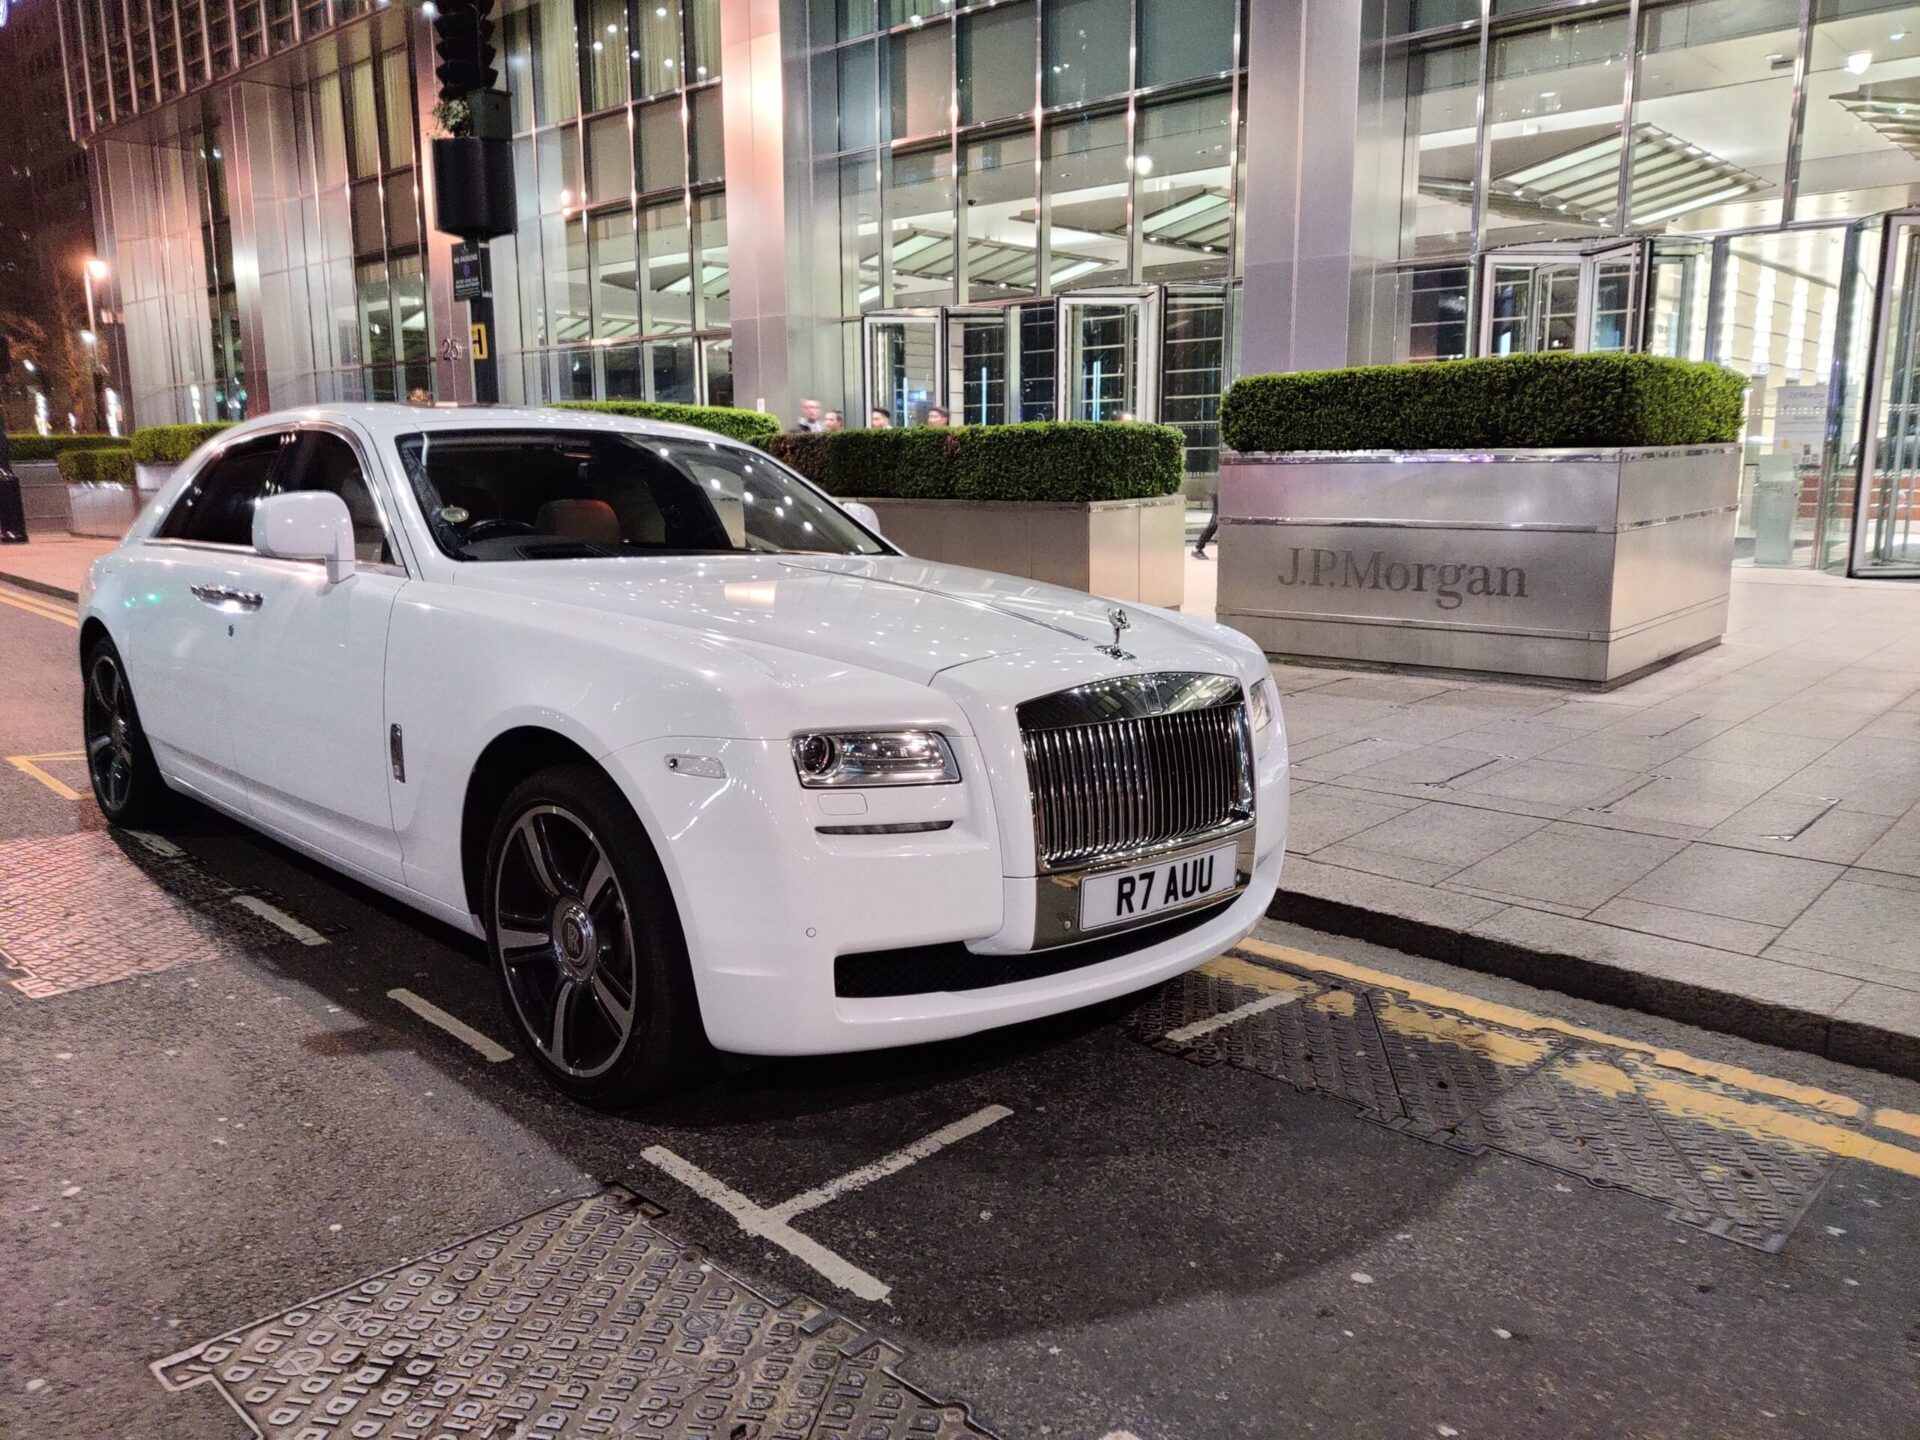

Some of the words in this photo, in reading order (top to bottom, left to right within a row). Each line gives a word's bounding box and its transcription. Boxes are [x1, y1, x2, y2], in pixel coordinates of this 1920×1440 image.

[1278, 548, 1529, 610] J.P.Morgan
[1116, 870, 1156, 917] R7
[1164, 855, 1214, 905] AUU
